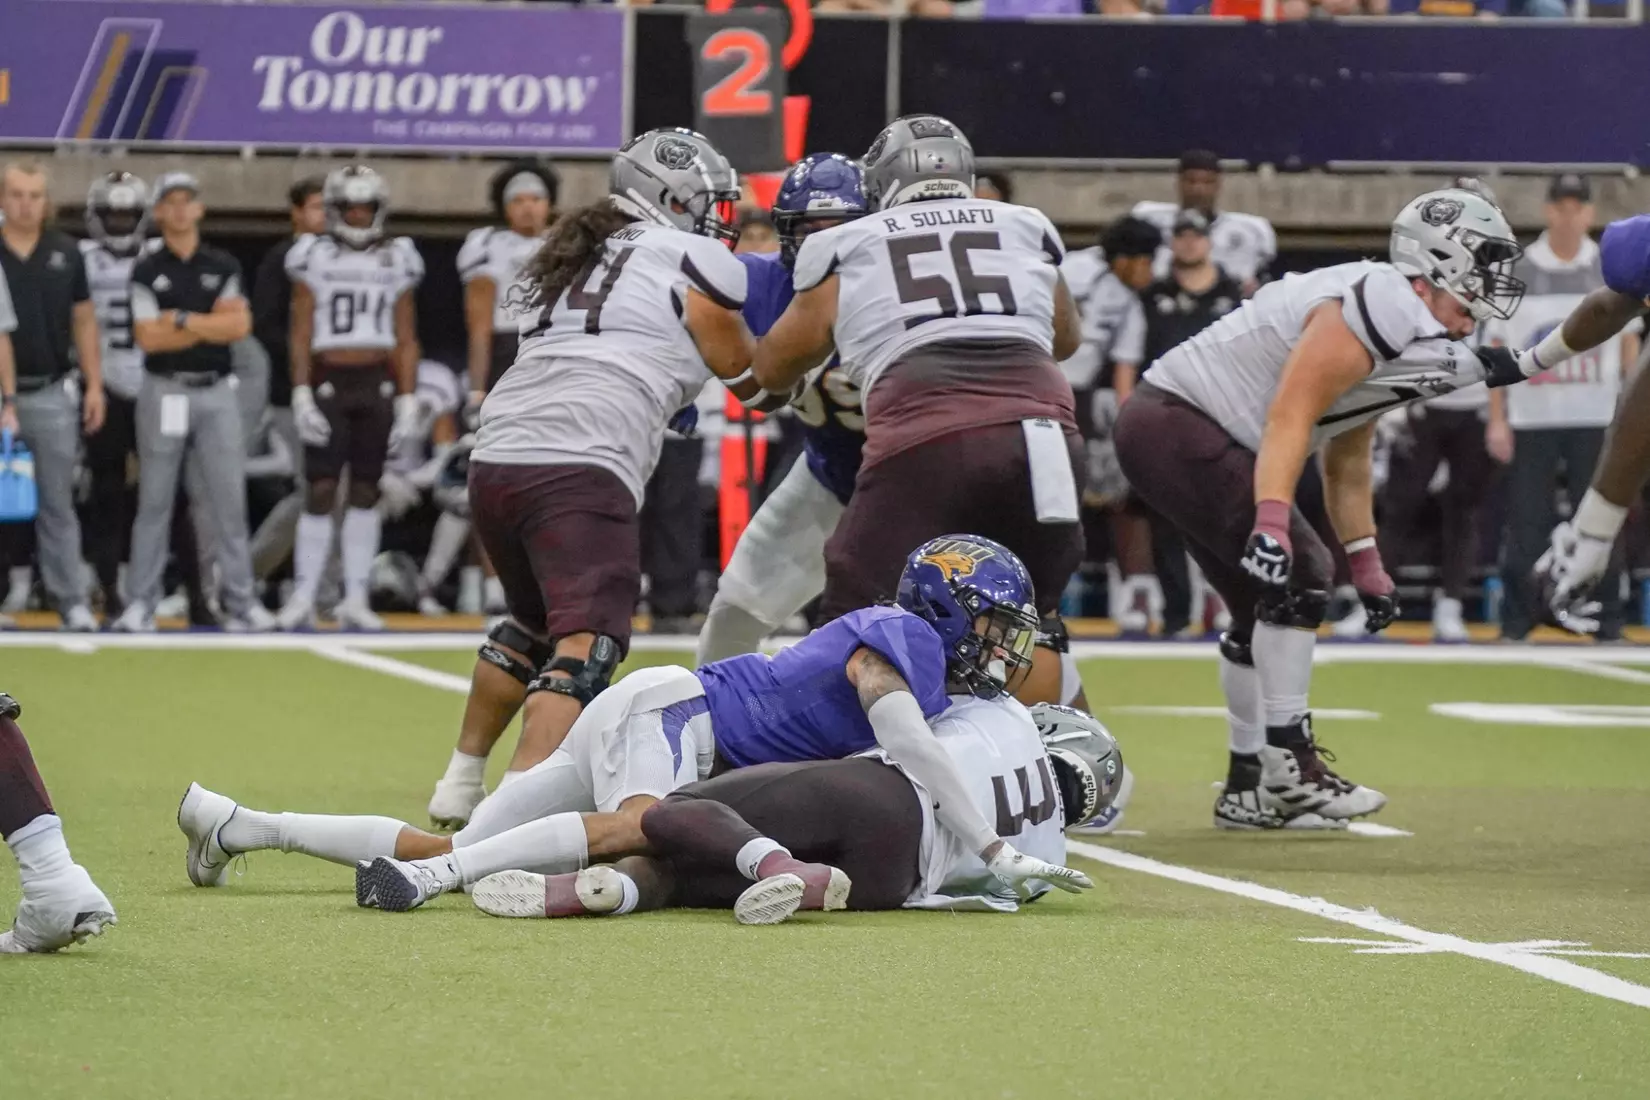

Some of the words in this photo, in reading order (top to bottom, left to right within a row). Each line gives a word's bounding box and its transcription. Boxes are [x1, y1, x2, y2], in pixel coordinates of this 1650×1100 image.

[310, 10, 444, 66] Our
[702, 27, 771, 116] 2
[253, 55, 598, 115] Tomorrow
[883, 217, 906, 232] R.
[910, 209, 995, 228] SULIAFU
[886, 230, 1017, 331] 56
[991, 757, 1056, 837] 3
